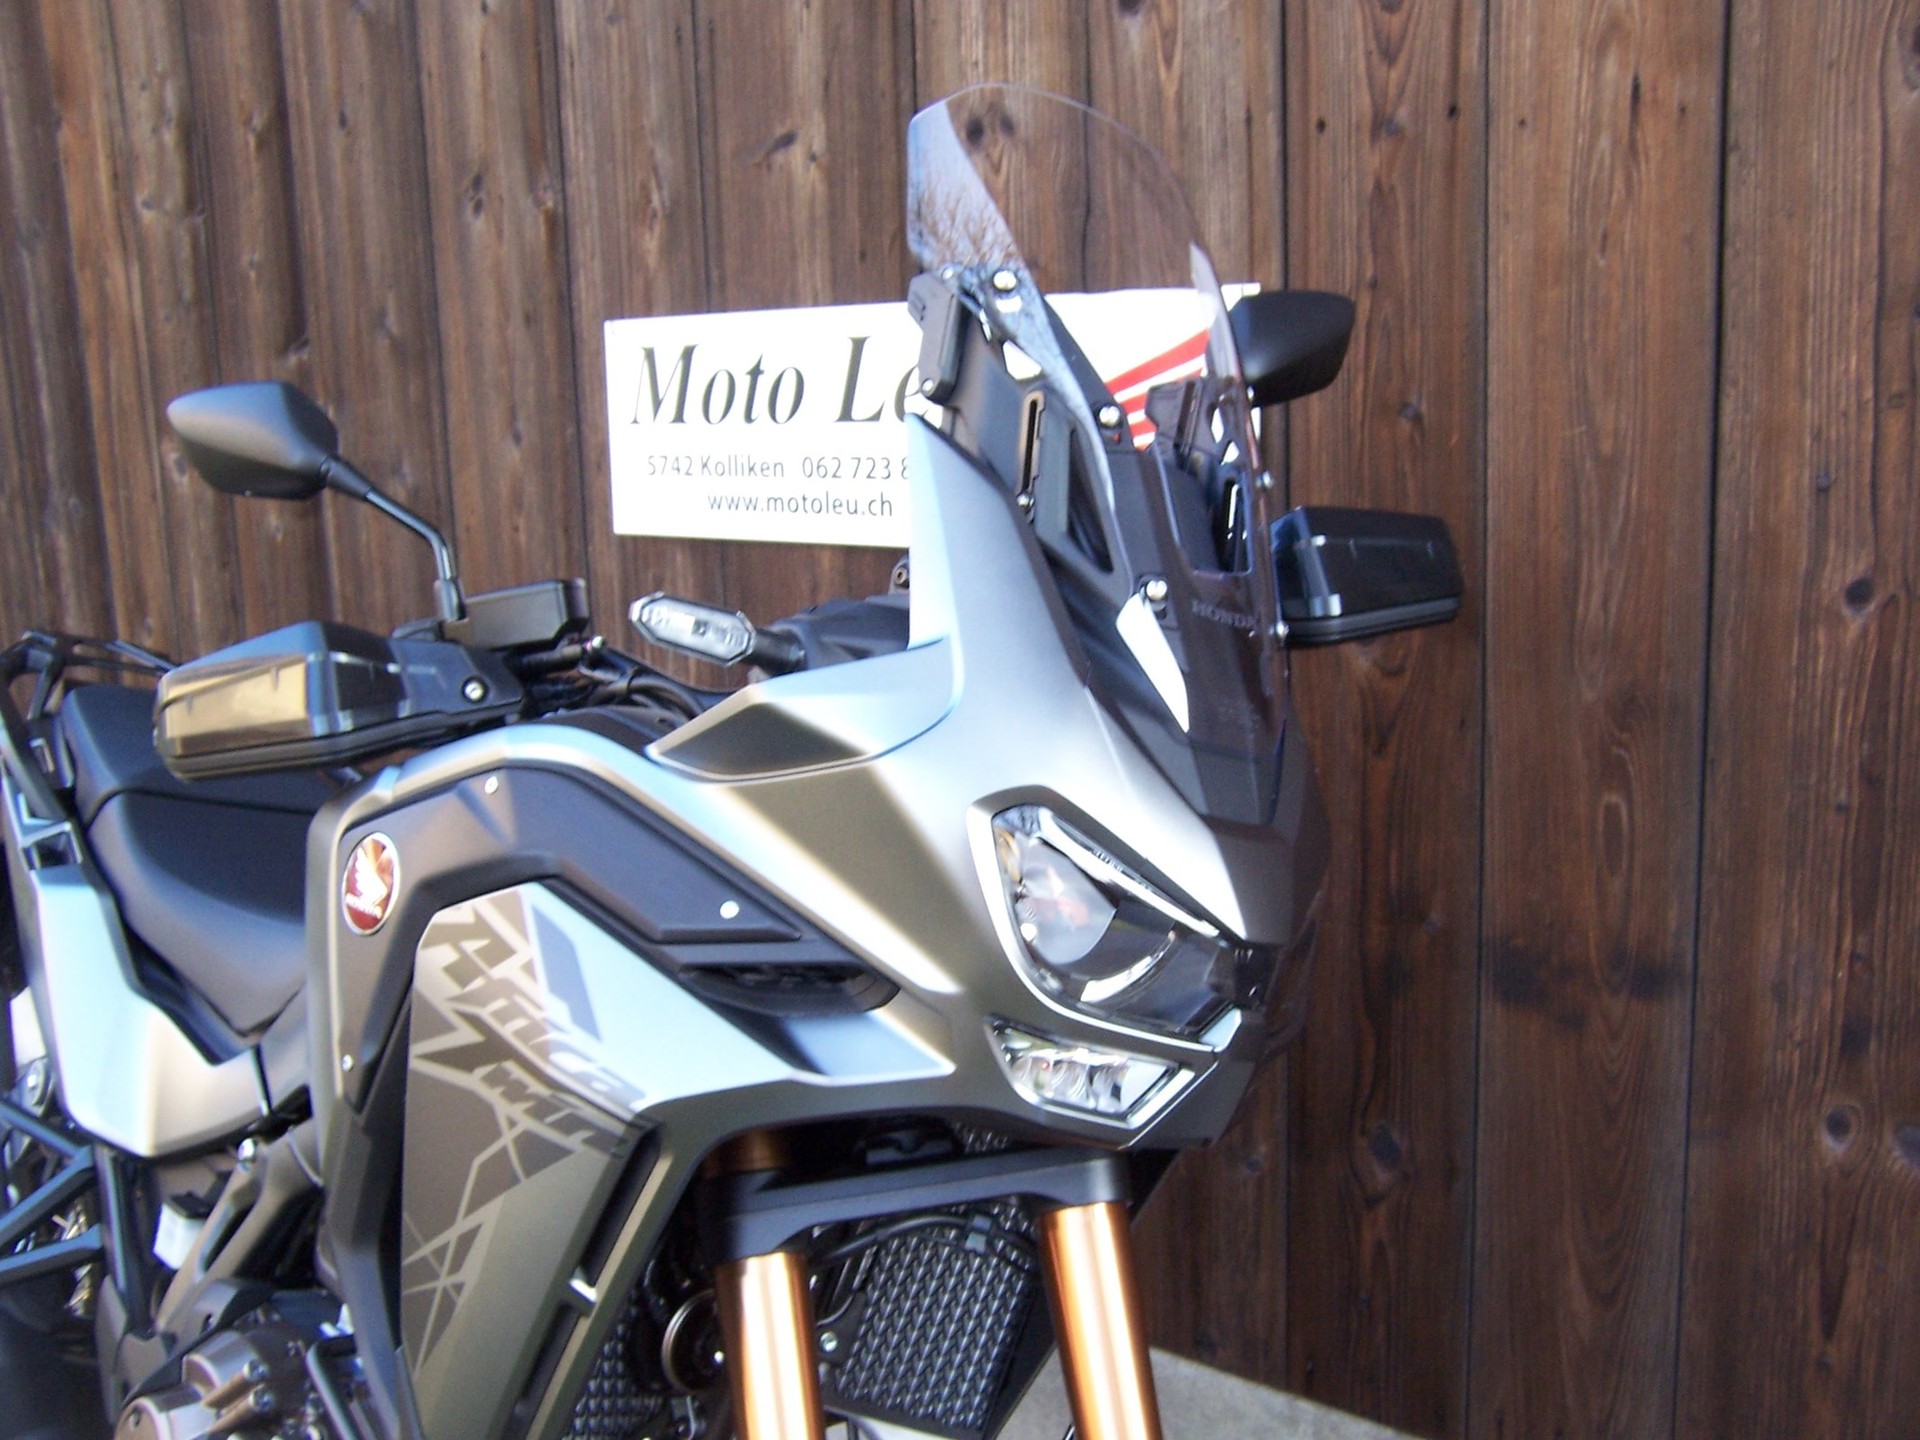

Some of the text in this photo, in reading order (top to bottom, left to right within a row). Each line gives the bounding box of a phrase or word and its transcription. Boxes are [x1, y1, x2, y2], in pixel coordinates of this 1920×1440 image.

[630, 344, 805, 425] Moto
[648, 455, 693, 476] 5742
[802, 456, 842, 478] 062
[851, 457, 891, 480] 723
[708, 491, 892, 516] www.motoleu.ch
